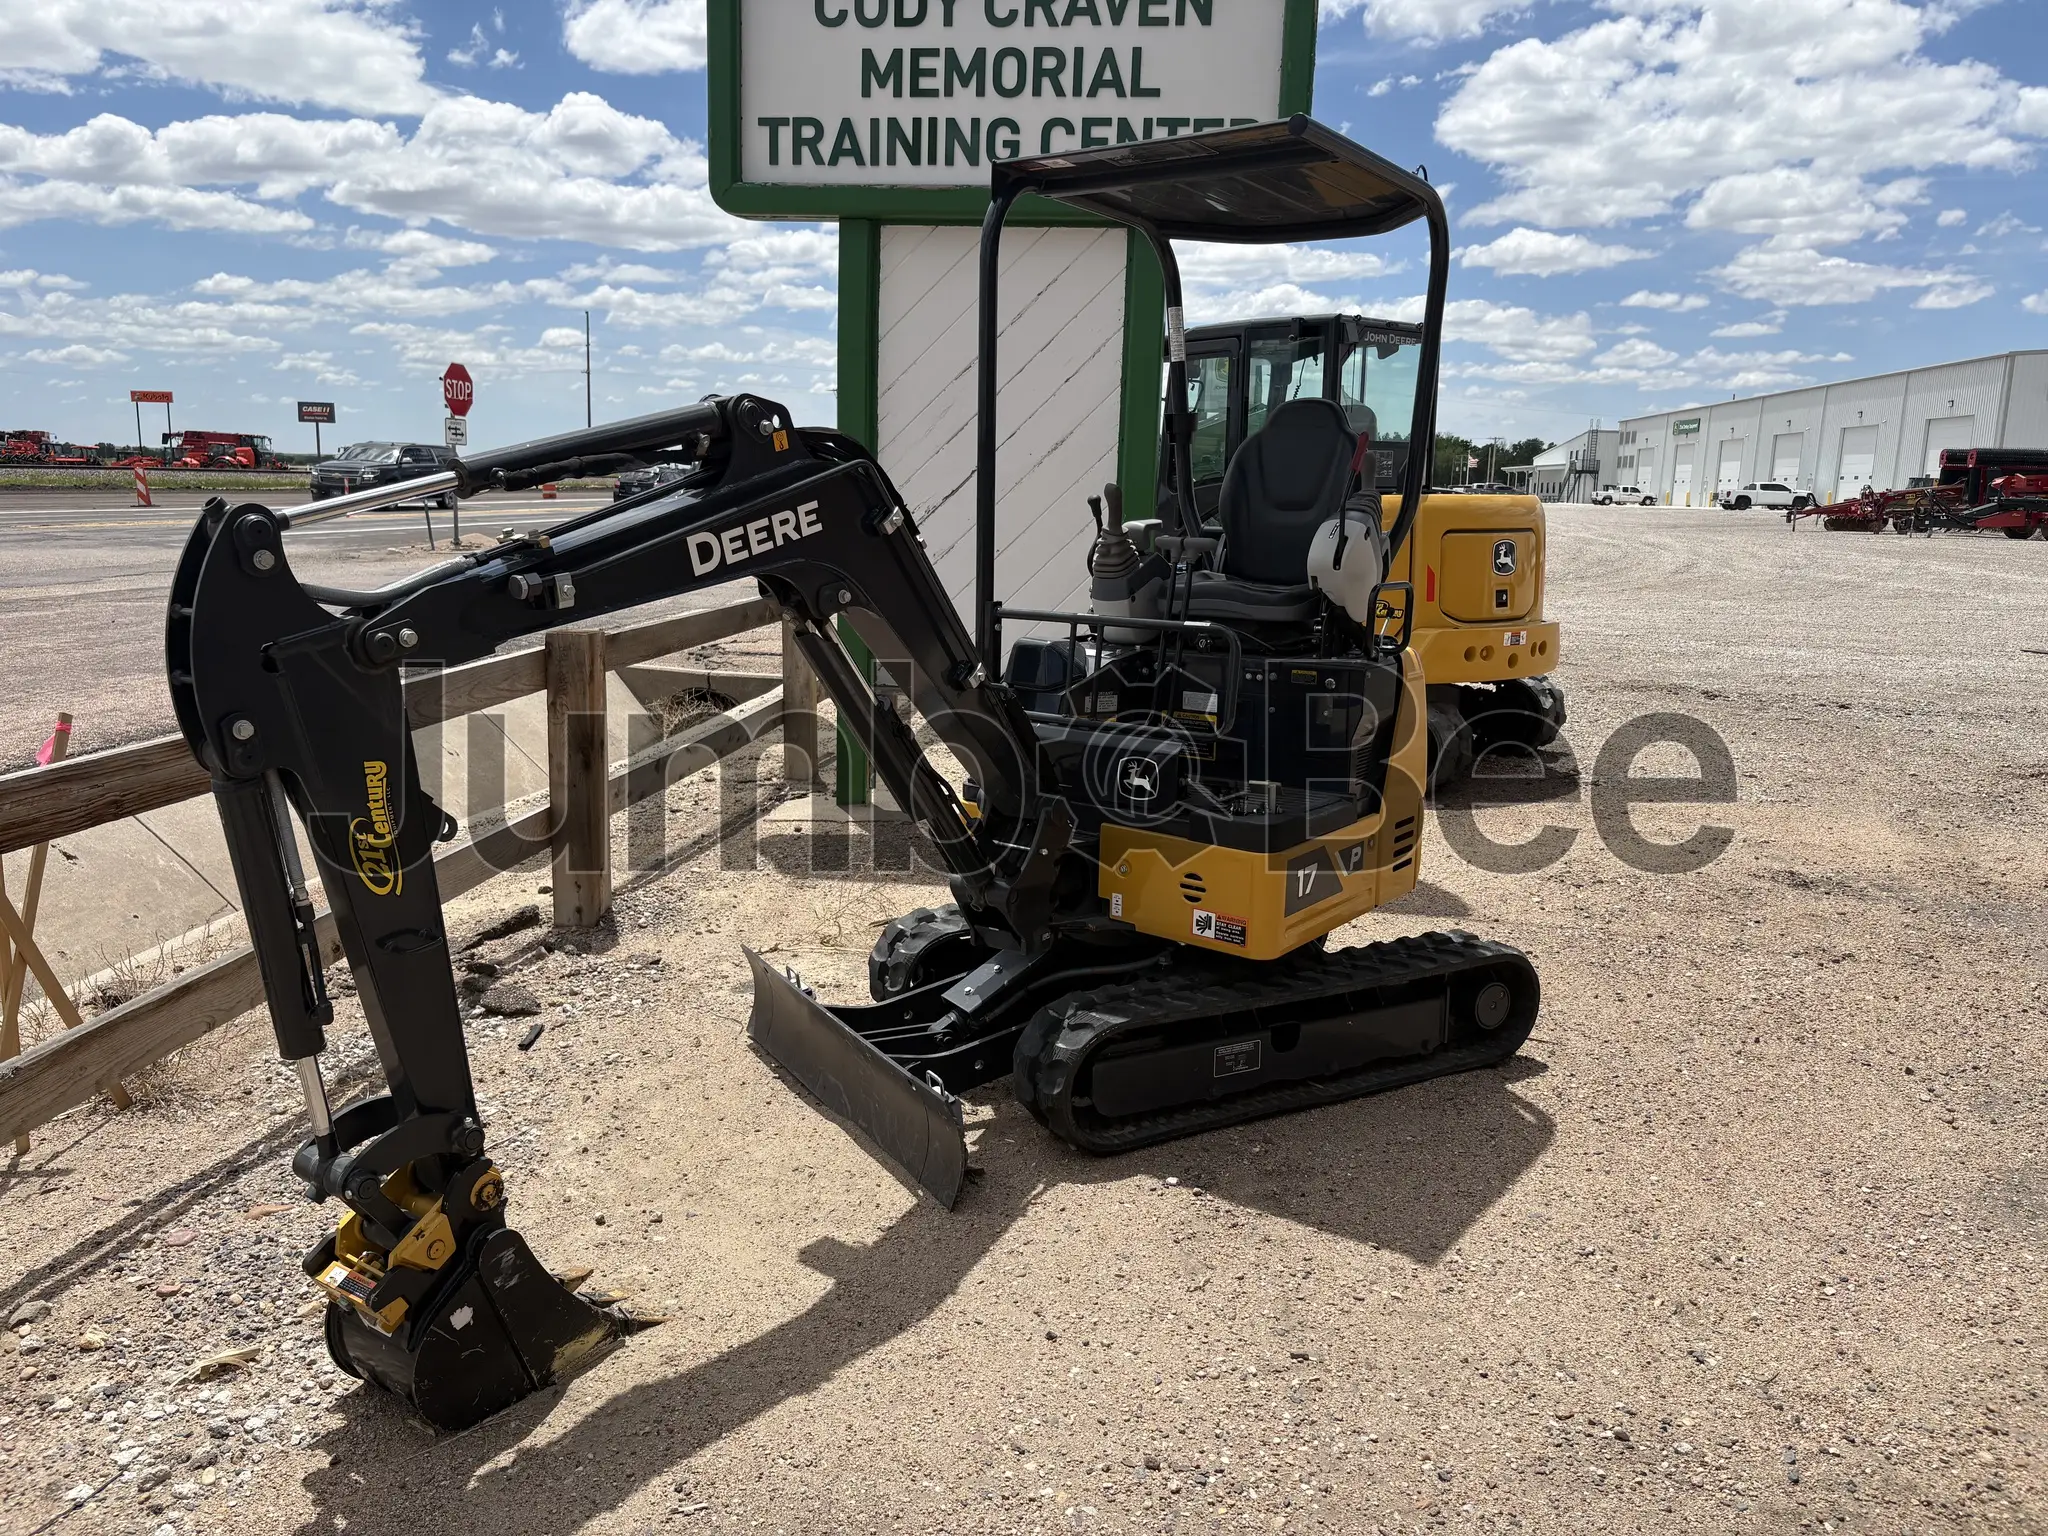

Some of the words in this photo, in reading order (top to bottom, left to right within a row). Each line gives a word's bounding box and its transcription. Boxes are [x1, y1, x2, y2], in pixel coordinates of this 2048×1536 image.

[860, 46, 1160, 99] MEMORIAL
[757, 116, 1021, 168] TRAINING
[1364, 331, 1387, 343] JOHN
[1389, 334, 1417, 345] DEERE
[143, 393, 170, 401] Kubota
[446, 379, 472, 401] STOP
[686, 500, 823, 577] DEERE
[355, 833, 393, 880] 21st
[1297, 862, 1318, 898] 17
[1349, 846, 1362, 871] P
